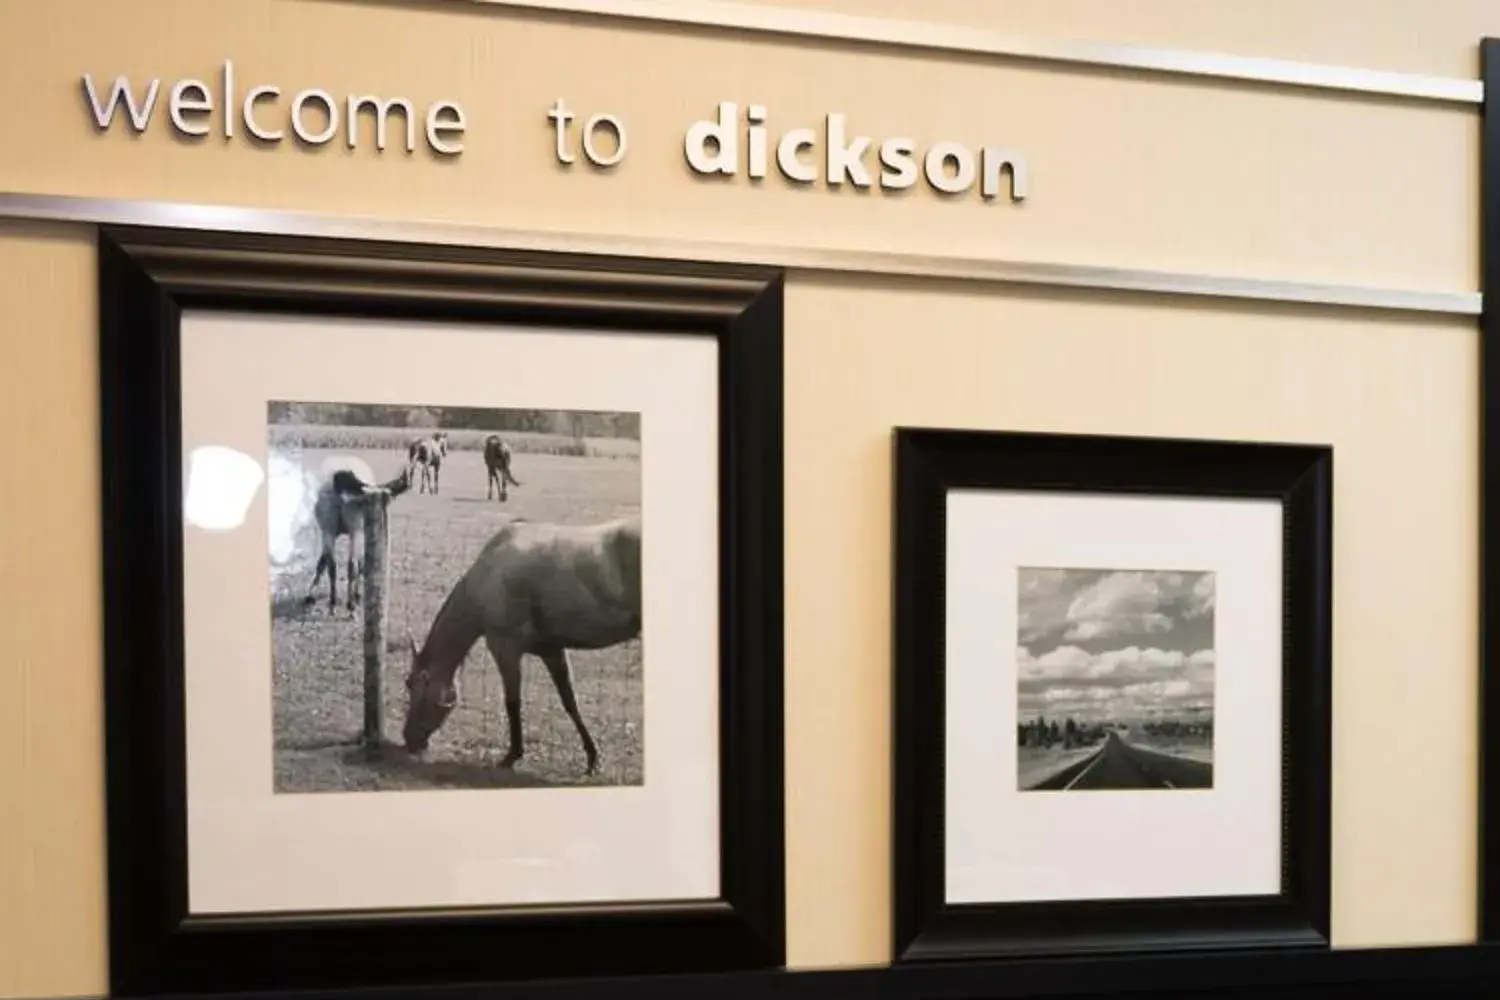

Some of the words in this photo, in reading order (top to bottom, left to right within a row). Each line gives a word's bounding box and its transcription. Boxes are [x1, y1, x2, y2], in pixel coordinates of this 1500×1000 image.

[82, 60, 465, 157] welcome
[548, 96, 628, 168] to
[684, 101, 1030, 200] dickson
